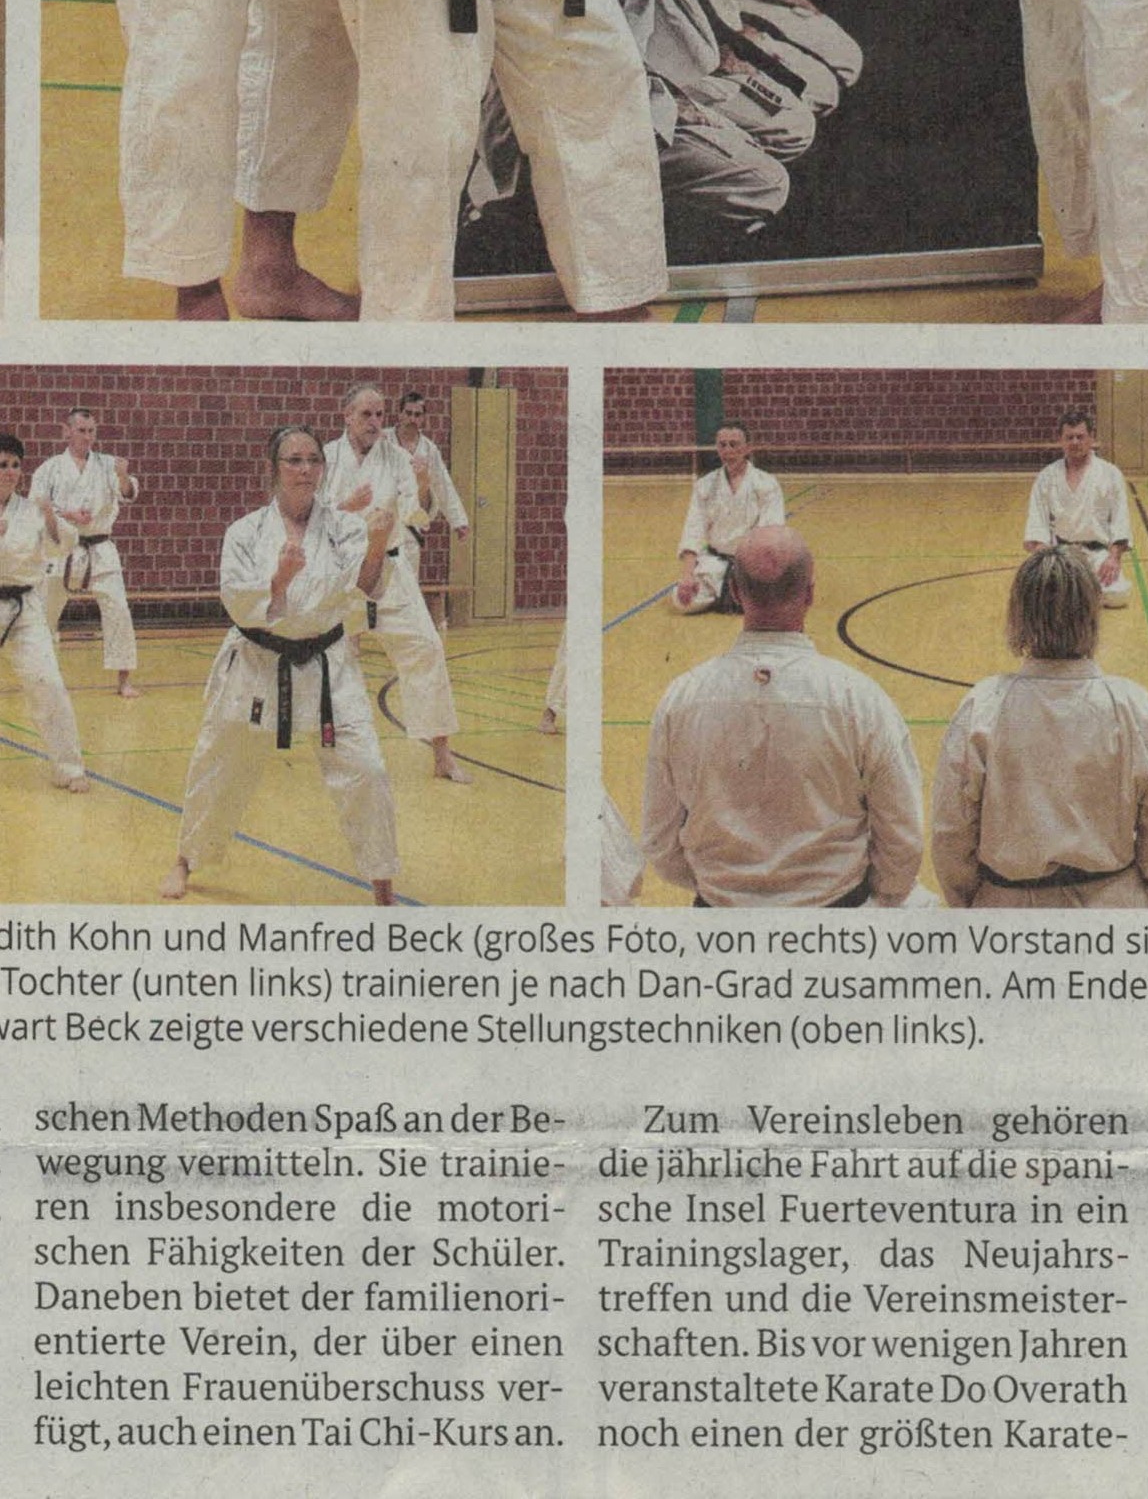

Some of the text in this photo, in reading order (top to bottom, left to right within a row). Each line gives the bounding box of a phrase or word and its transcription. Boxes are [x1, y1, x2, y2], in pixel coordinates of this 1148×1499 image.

[70, 921, 151, 951] Kohn
[165, 921, 225, 952] und
[240, 922, 374, 952] Manfred
[389, 923, 463, 952] Beck
[474, 922, 595, 961] (großes
[608, 923, 685, 958] Foto,
[697, 931, 755, 953] von
[769, 924, 877, 959] rechts)
[887, 932, 956, 954] vom
[969, 924, 1113, 955] Vorstand
[0, 965, 123, 996] Tochter
[133, 967, 237, 1002] (unten
[250, 966, 332, 1002] links)
[342, 968, 499, 998] trainieren
[508, 969, 538, 1006] je
[550, 968, 625, 998] nach
[639, 968, 792, 999] Dan-Grad
[804, 977, 991, 999] zusammen.
[1002, 971, 1055, 999] Am
[1069, 969, 1147, 1000] Ende
[66, 1011, 140, 1041] Beck
[149, 1013, 243, 1050] zeigte
[252, 1012, 468, 1043] verschiedene
[478, 1013, 781, 1052] Stellungstechniken
[791, 1014, 883, 1049] (oben
[894, 1014, 984, 1050] links).
[35, 1235, 564, 1273] schen Fähigkeiten der Schüler.
[598, 1237, 1128, 1275] Trainingslager, das Neujahrs-
[35, 1326, 563, 1362] entierte Verein, der über einen
